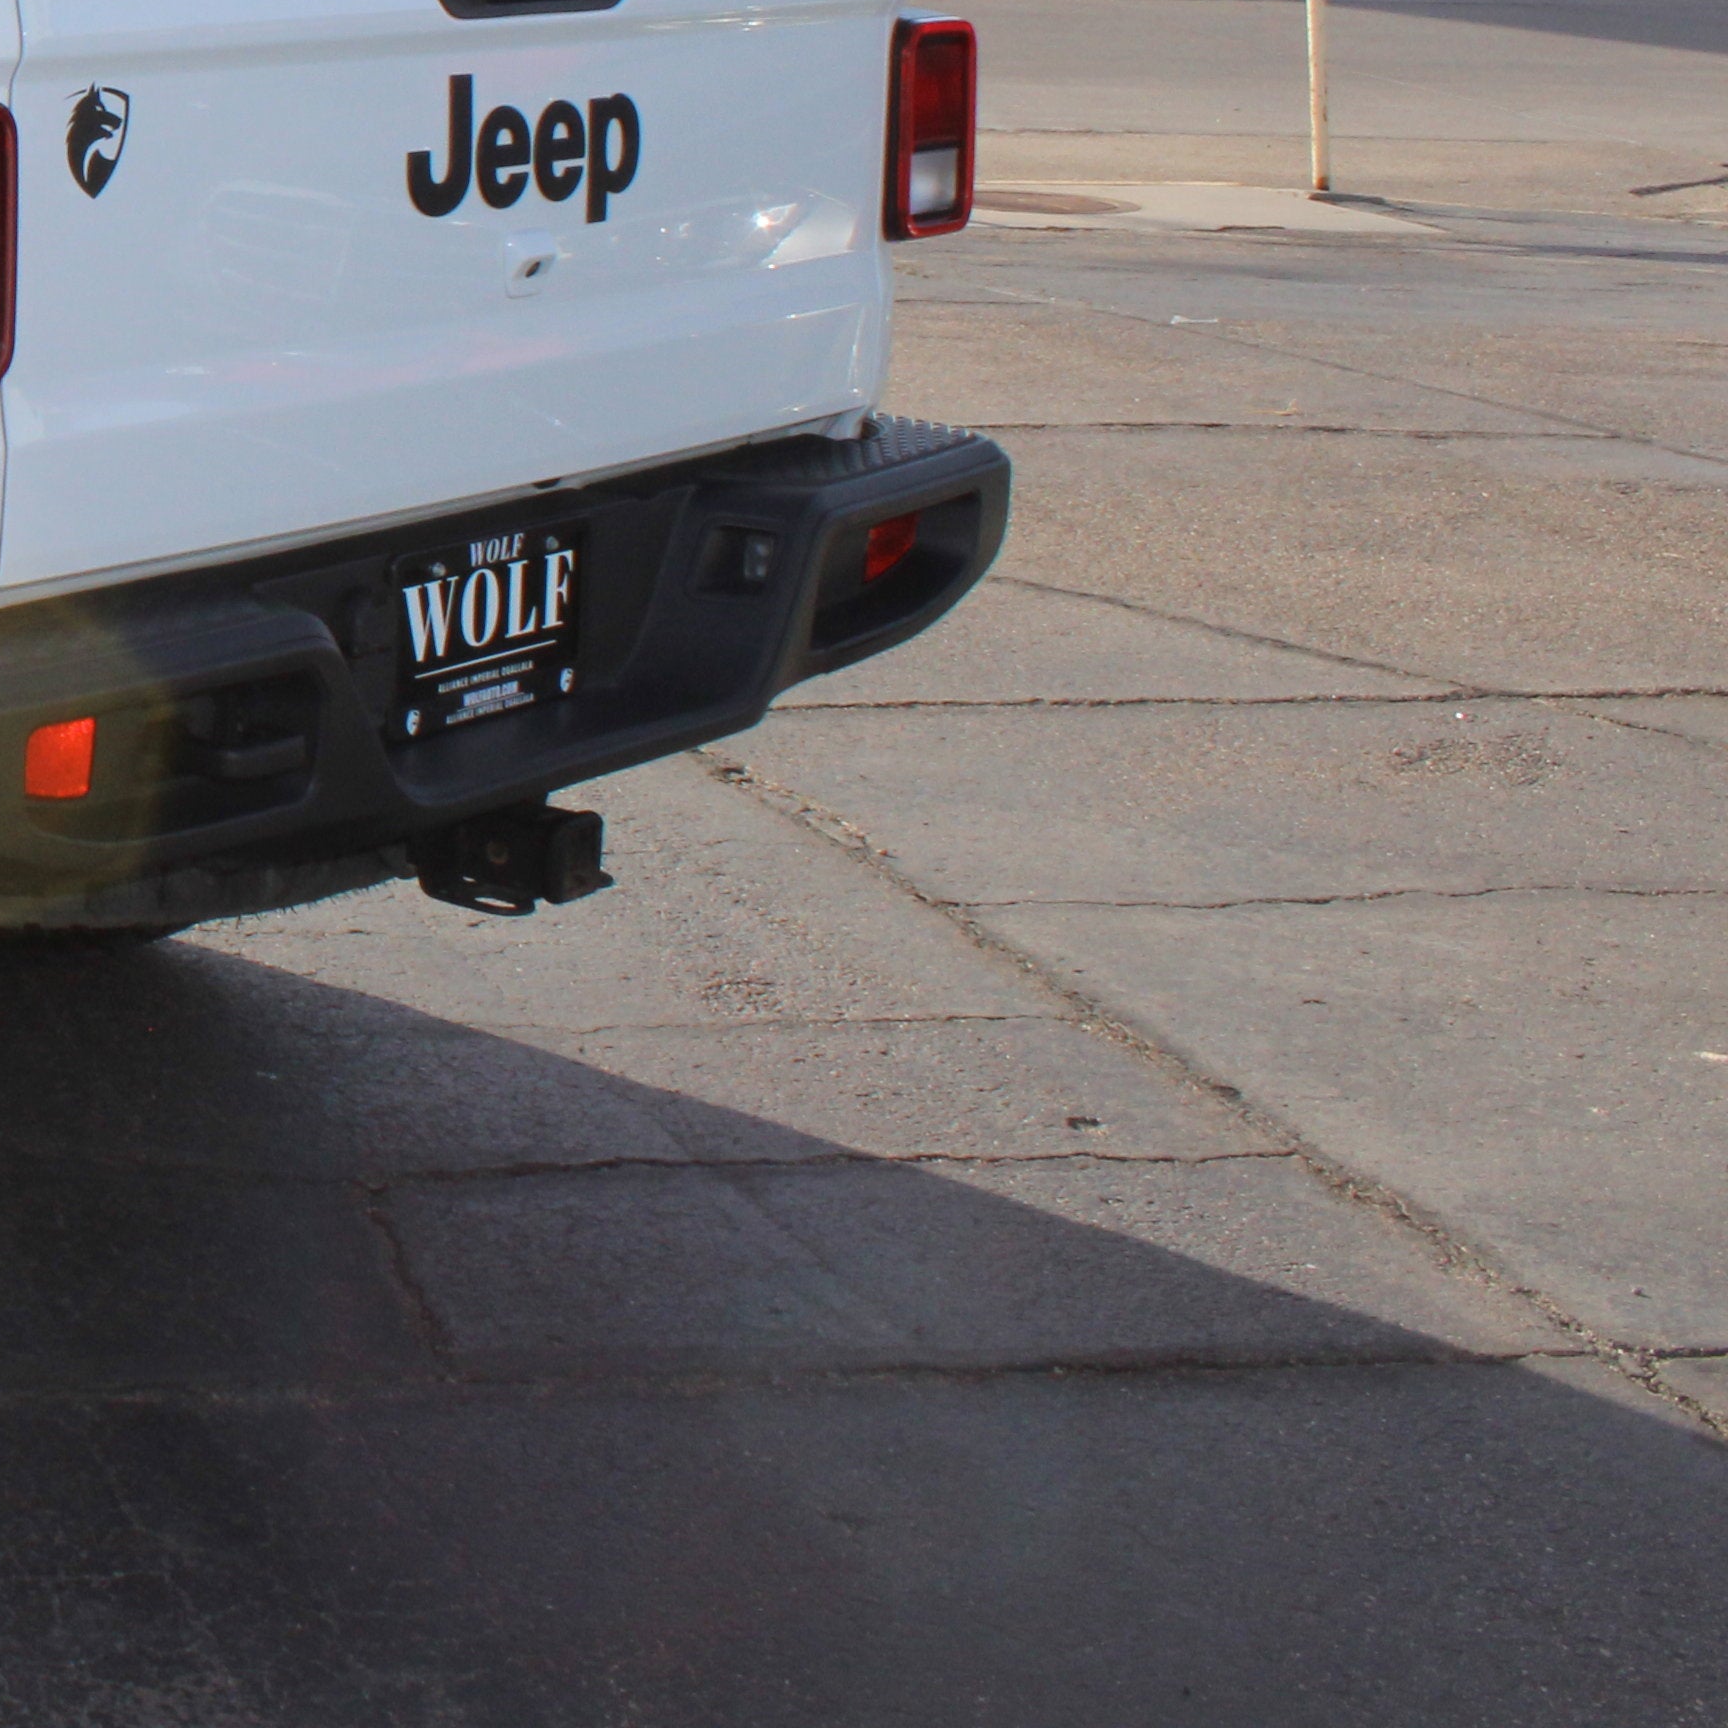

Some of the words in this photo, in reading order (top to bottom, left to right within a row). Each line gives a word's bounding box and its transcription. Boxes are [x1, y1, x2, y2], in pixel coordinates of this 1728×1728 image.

[406, 73, 641, 224] Jeep
[402, 549, 574, 663] WOLF
[469, 532, 525, 568] WOLF
